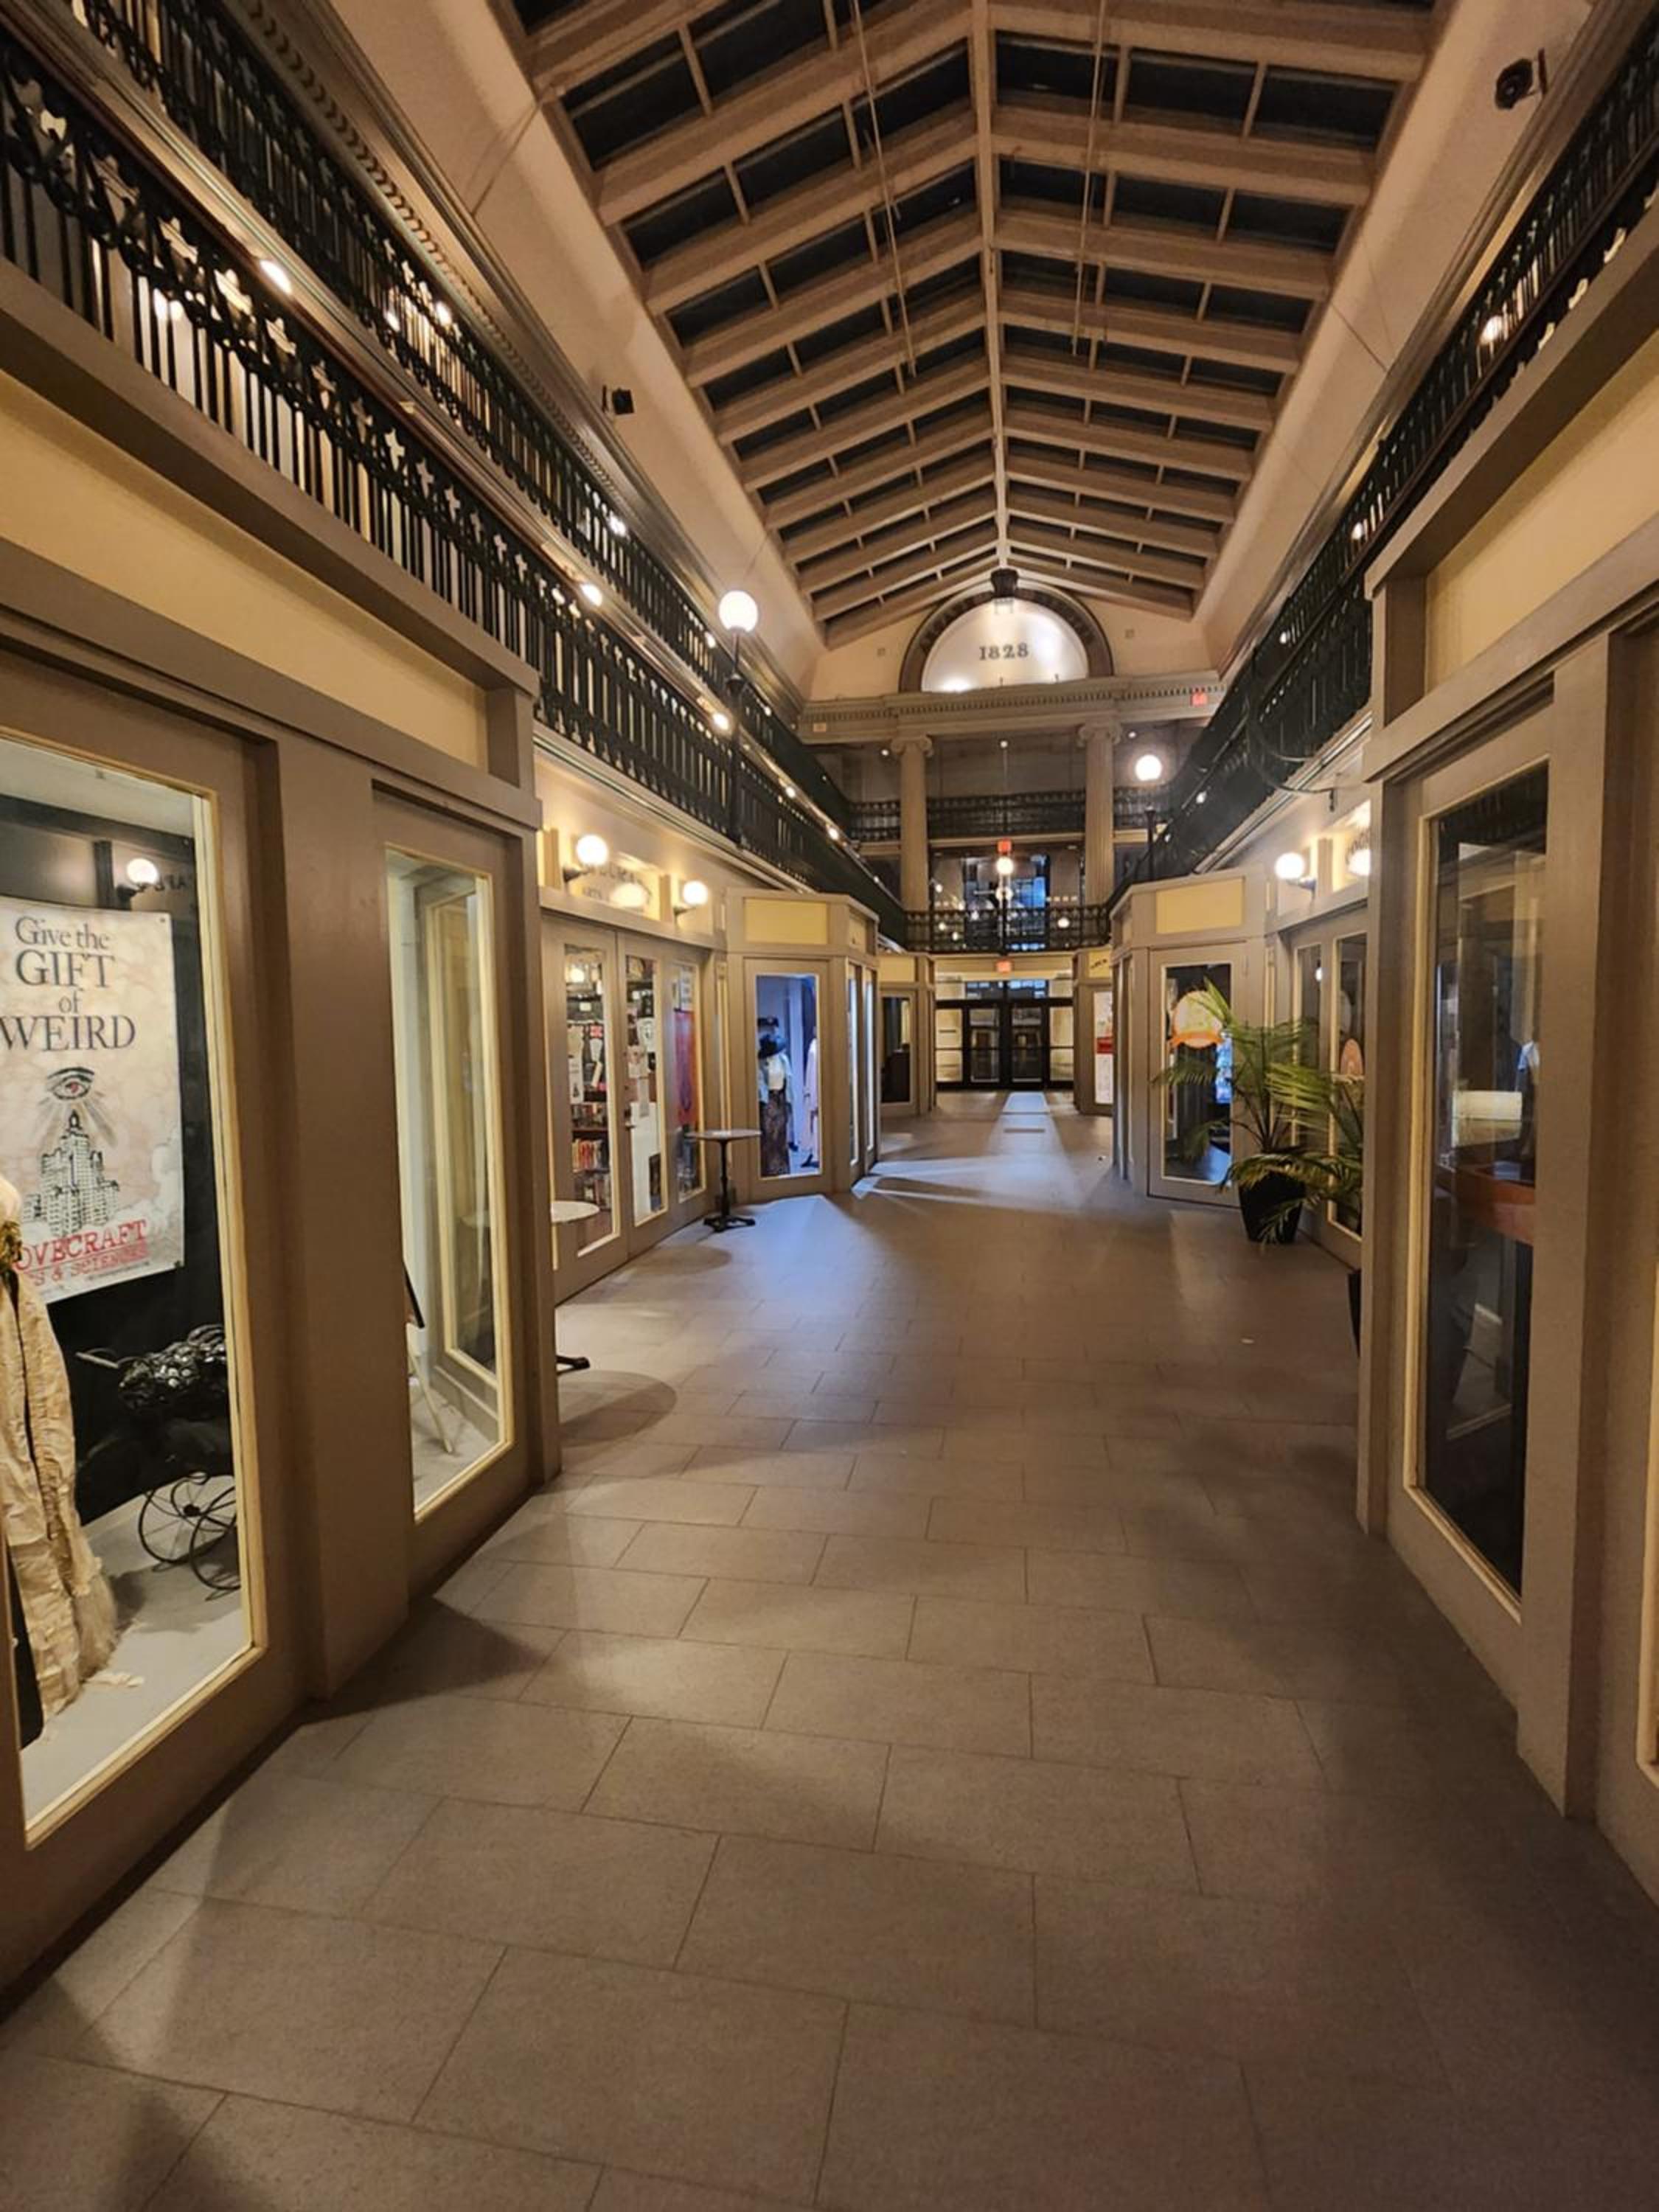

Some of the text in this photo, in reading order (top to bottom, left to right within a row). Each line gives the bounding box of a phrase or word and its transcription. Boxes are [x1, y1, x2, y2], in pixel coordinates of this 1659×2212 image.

[978, 641, 1029, 661] 1828
[15, 916, 110, 950] Give the
[15, 949, 116, 988] GIFT
[58, 987, 84, 1014] of
[0, 1015, 136, 1051] WEIRD
[13, 1219, 147, 1270] OVECRAFT
